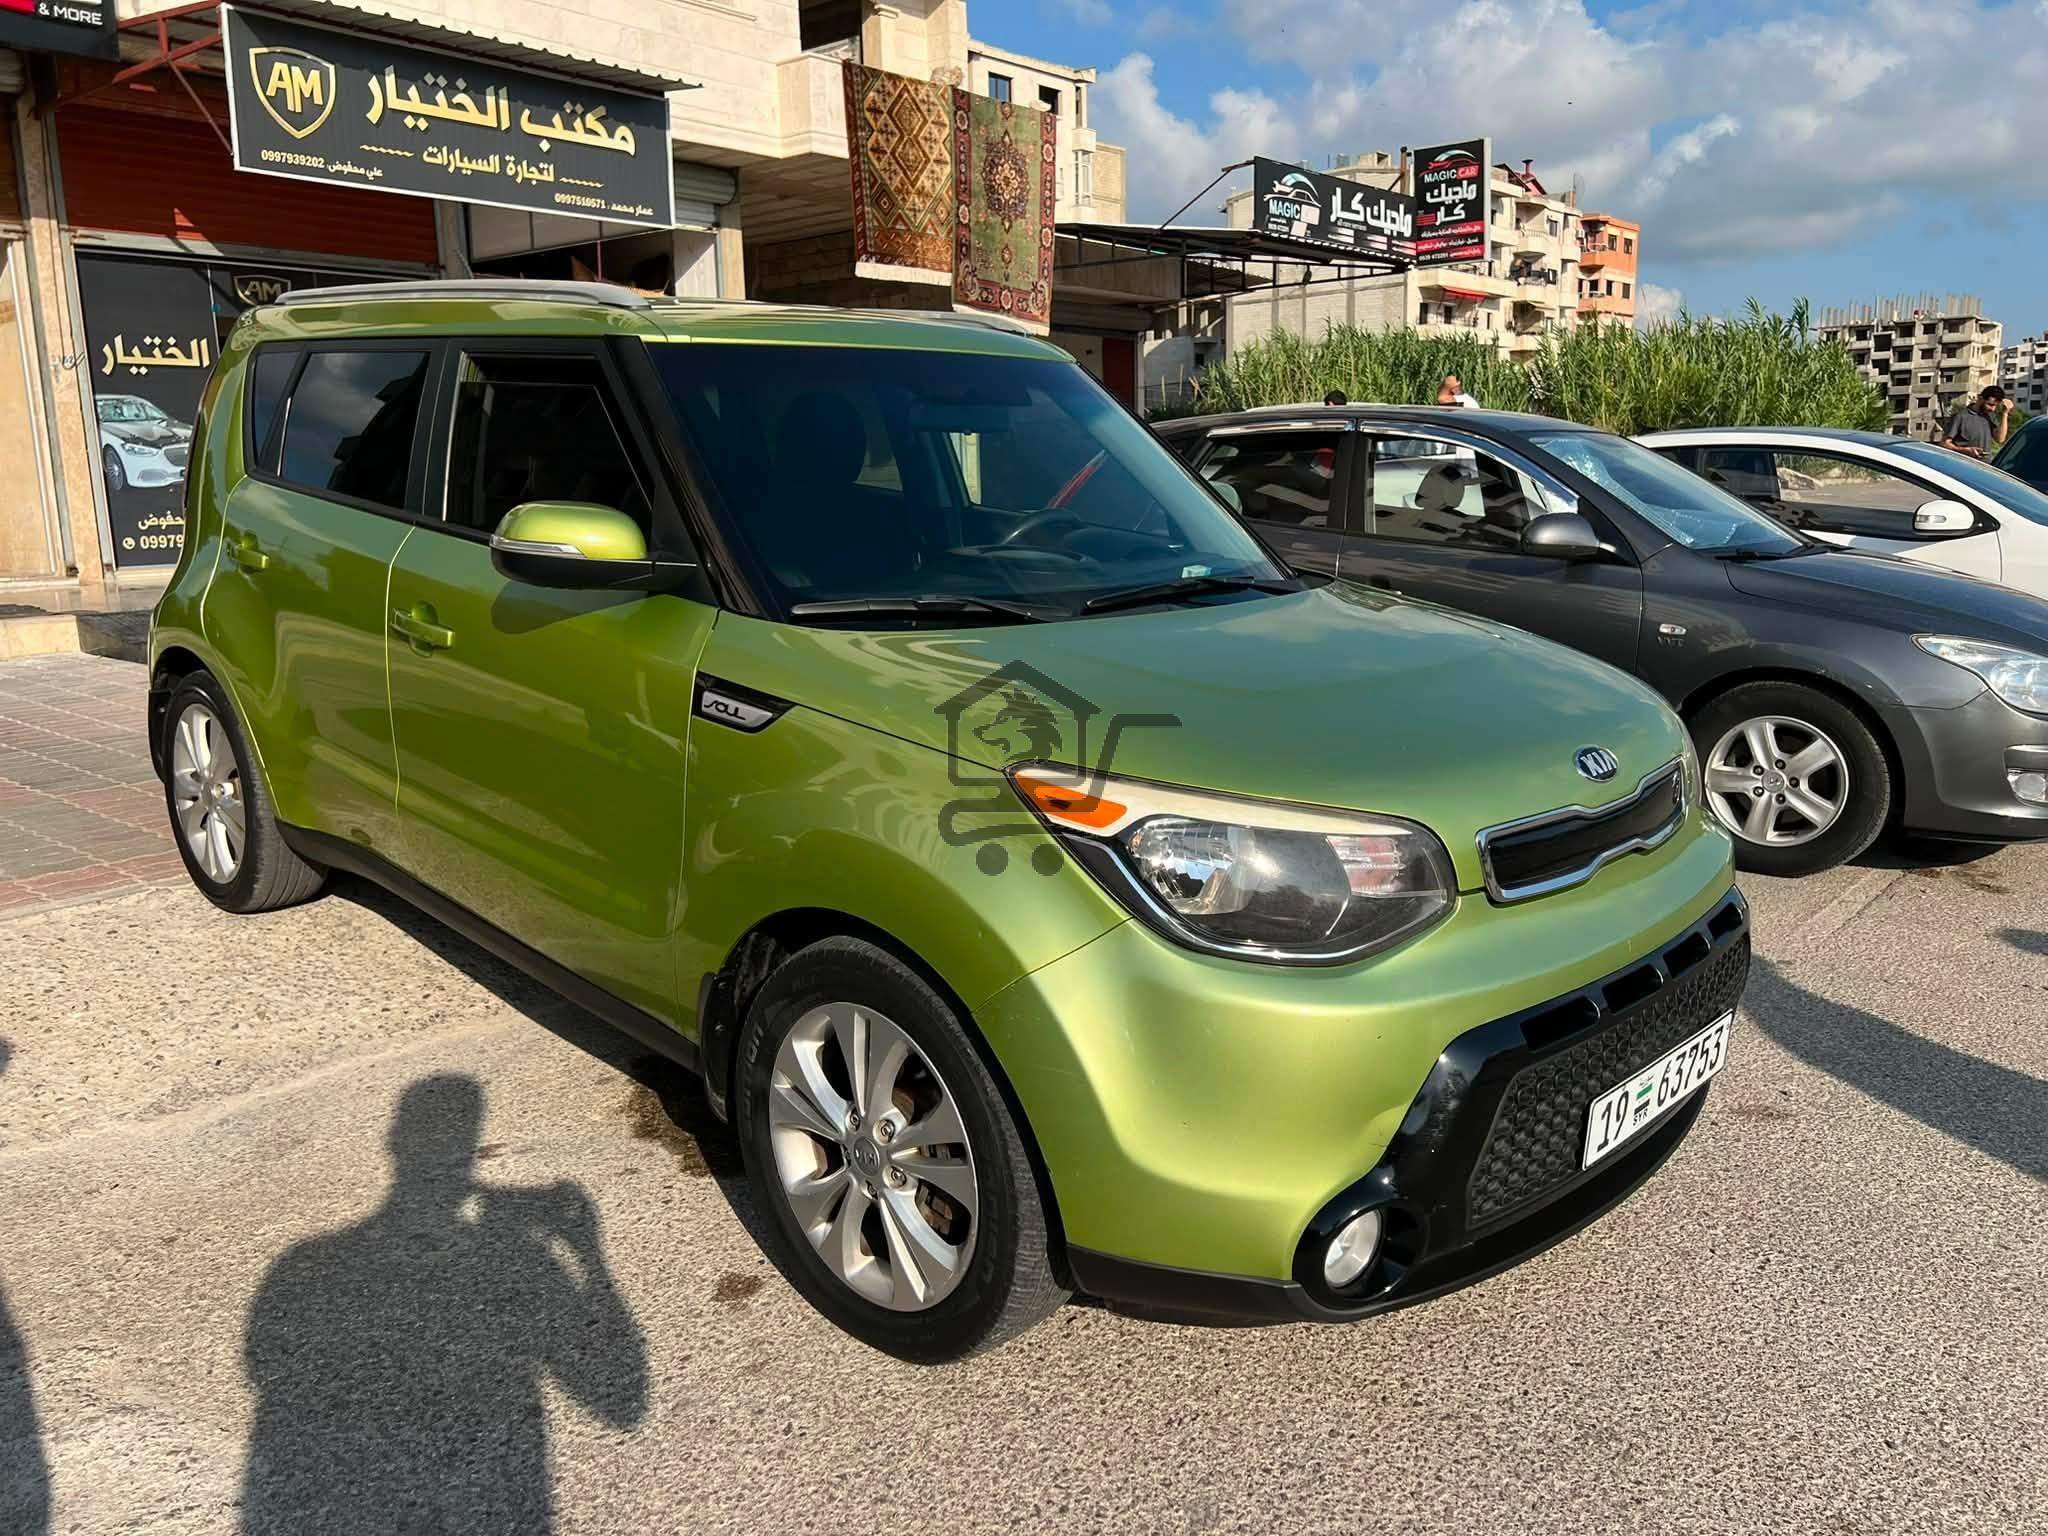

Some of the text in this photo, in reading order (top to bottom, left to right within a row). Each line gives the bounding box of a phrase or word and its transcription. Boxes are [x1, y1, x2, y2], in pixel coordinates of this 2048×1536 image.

[39, 2, 103, 26] & MORE
[265, 61, 324, 113] AM
[365, 63, 637, 157] مكتب الختيار
[260, 149, 325, 169] 0997939202
[422, 145, 555, 186] لتجارة السيارات
[365, 166, 384, 181] علي
[1424, 169, 1457, 184] MAGIC
[1329, 186, 1365, 223] كار
[1425, 180, 1477, 205] ماجيك
[1268, 198, 1301, 220] MAGIC
[1366, 198, 1412, 238] ماجيك
[1435, 203, 1466, 226] كار
[101, 333, 210, 376] الختيار
[138, 510, 184, 531] حفوض
[140, 534, 184, 549] 09979
[1580, 750, 1617, 777] KIA
[1597, 1025, 1724, 1153] 19 63753
[1633, 1108, 1649, 1127] SYR
